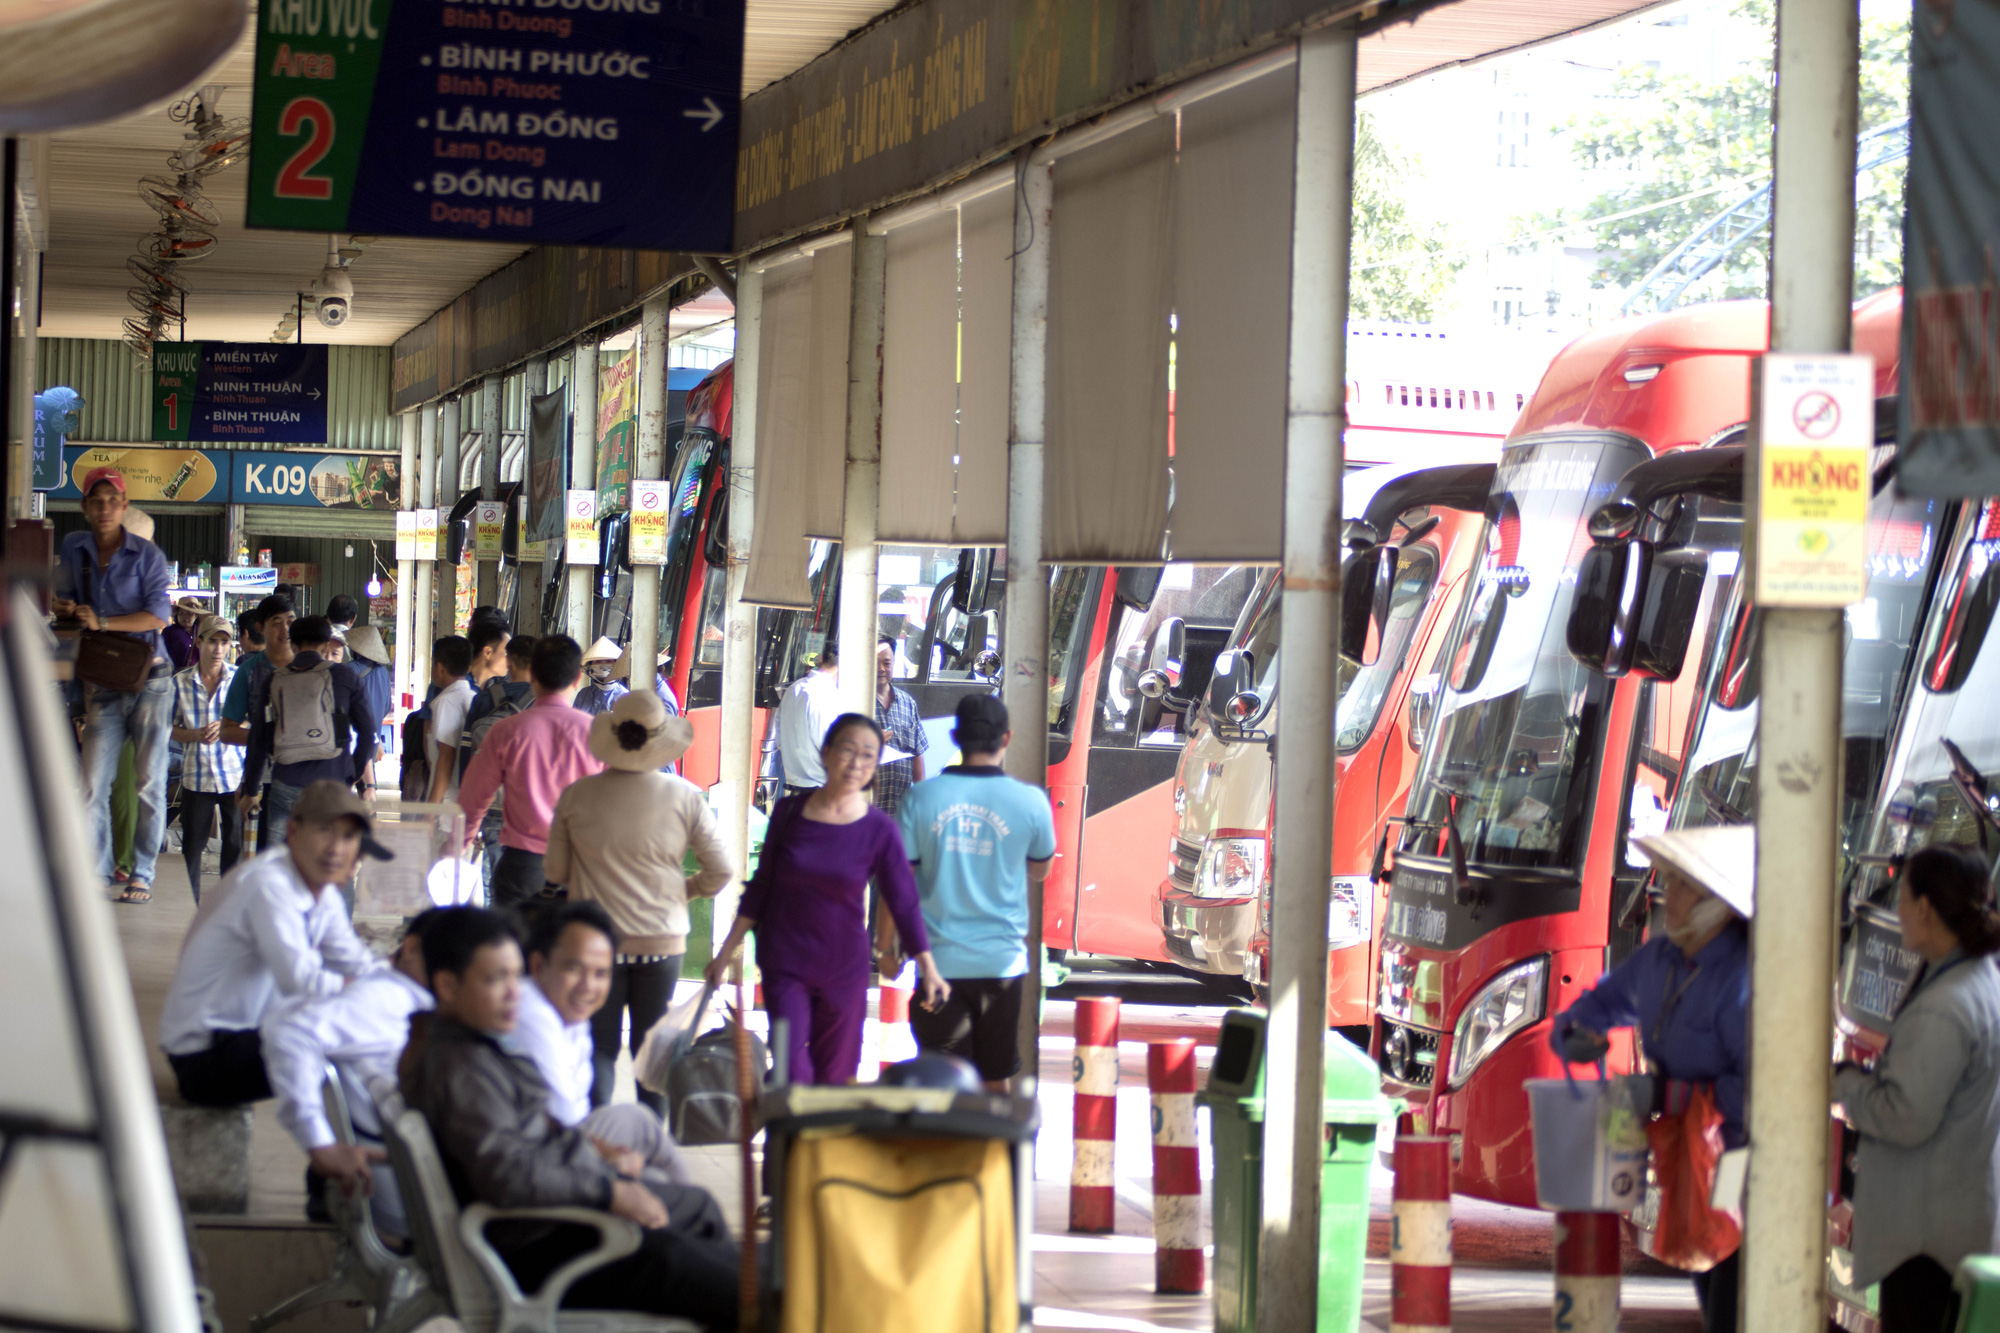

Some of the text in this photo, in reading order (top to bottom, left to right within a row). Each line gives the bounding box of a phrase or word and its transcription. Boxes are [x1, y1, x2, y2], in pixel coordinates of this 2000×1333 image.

[442, 9, 572, 38] Binh Duong
[272, 44, 336, 79] Area
[439, 42, 650, 79] BÌNH PHƯỚC
[438, 75, 561, 100] Binh Phuoc
[436, 107, 509, 134] LÂM
[275, 97, 335, 199] 2
[434, 138, 546, 167] Lam Dong
[542, 178, 601, 202] NAI
[431, 202, 533, 228] Dong Nai
[157, 350, 197, 378] KHU VỰC
[214, 364, 252, 374] Western
[254, 351, 278, 364] TÂY
[159, 374, 181, 387] Area
[213, 381, 302, 396] NINH THUẬN
[163, 392, 178, 430] 1
[212, 394, 267, 404] Ninh Thuan
[212, 423, 265, 434] Binh Thuan
[213, 409, 301, 426] BÌNH THUẬN
[93, 454, 110, 462] TEA
[245, 463, 307, 496] K.09
[1771, 449, 1859, 494] KHÔNG
[634, 512, 665, 527] KHÔNG
[237, 573, 268, 581] ALASKA
